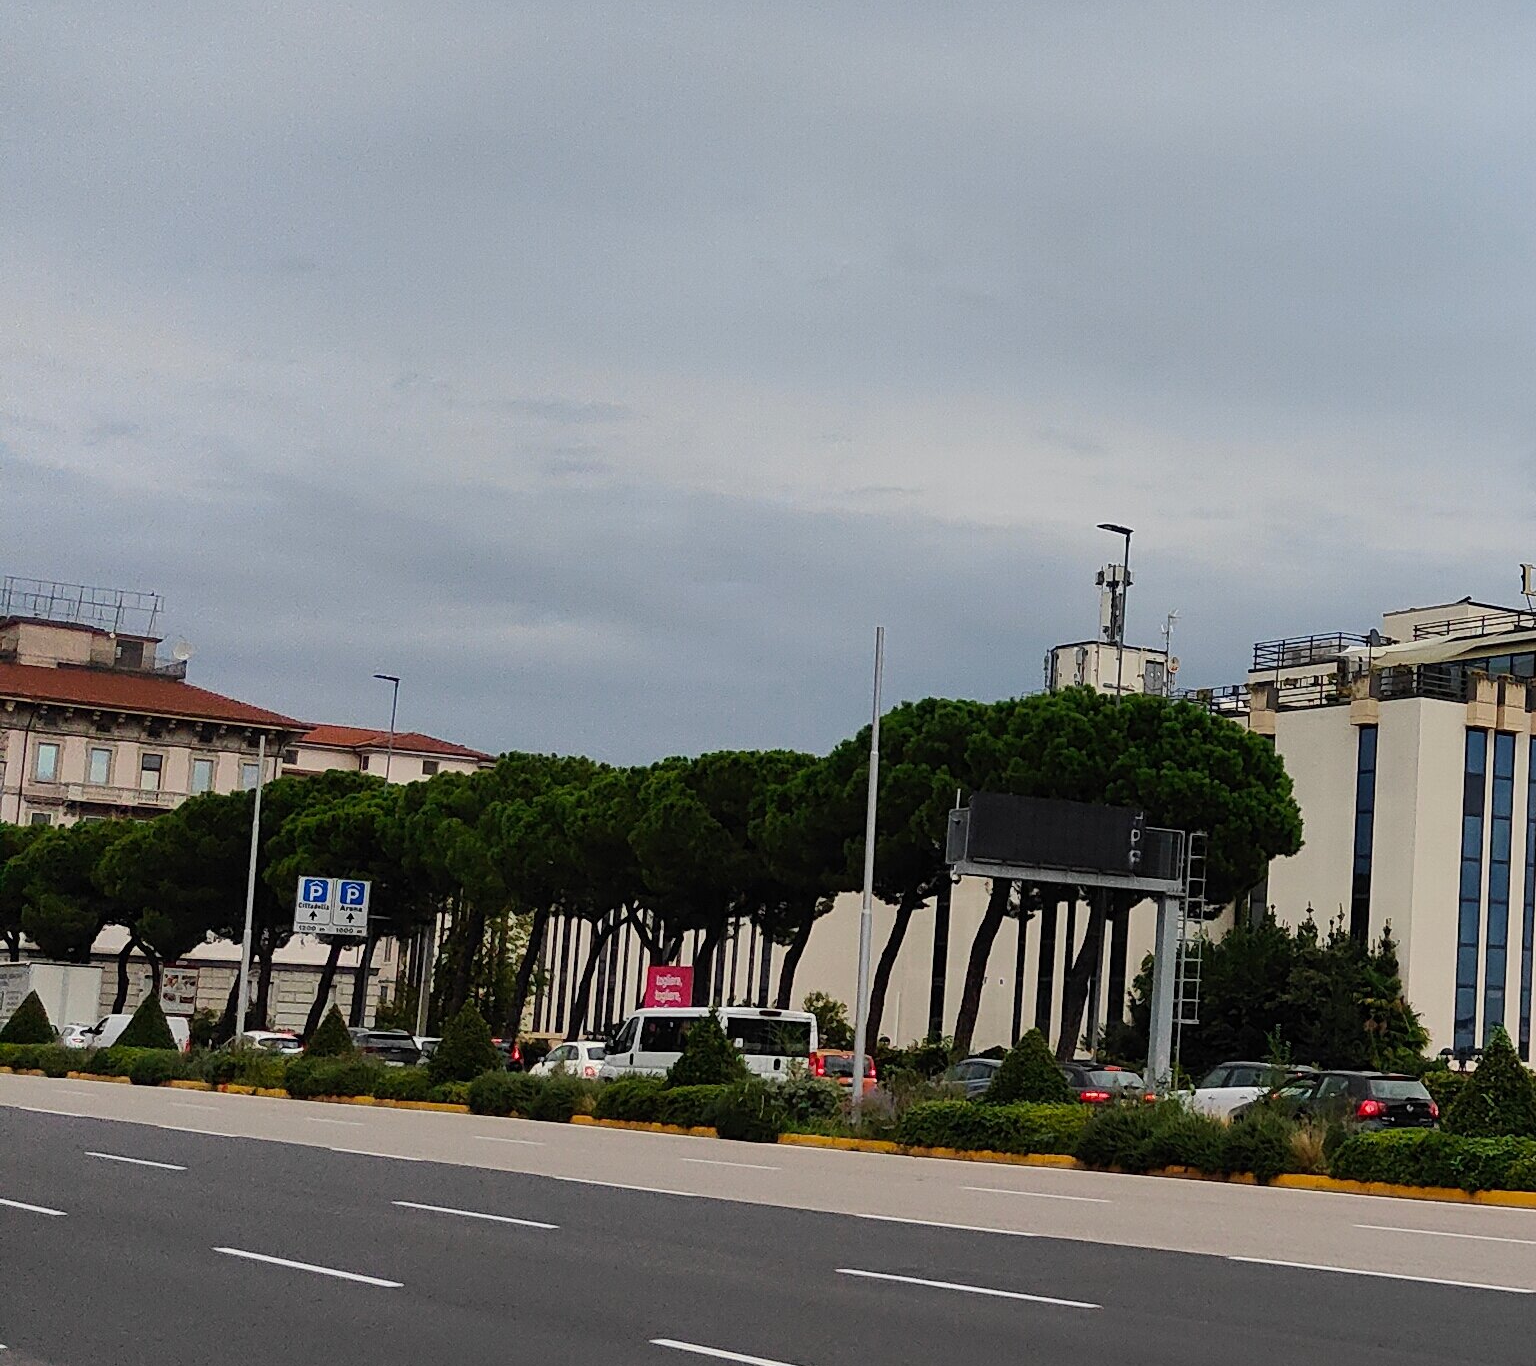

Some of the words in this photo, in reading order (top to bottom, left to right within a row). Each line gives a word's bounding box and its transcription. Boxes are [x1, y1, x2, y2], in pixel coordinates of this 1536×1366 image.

[309, 885, 323, 902] P
[346, 888, 360, 904] P
[298, 902, 330, 911] Cittadella
[340, 905, 363, 913] Arena
